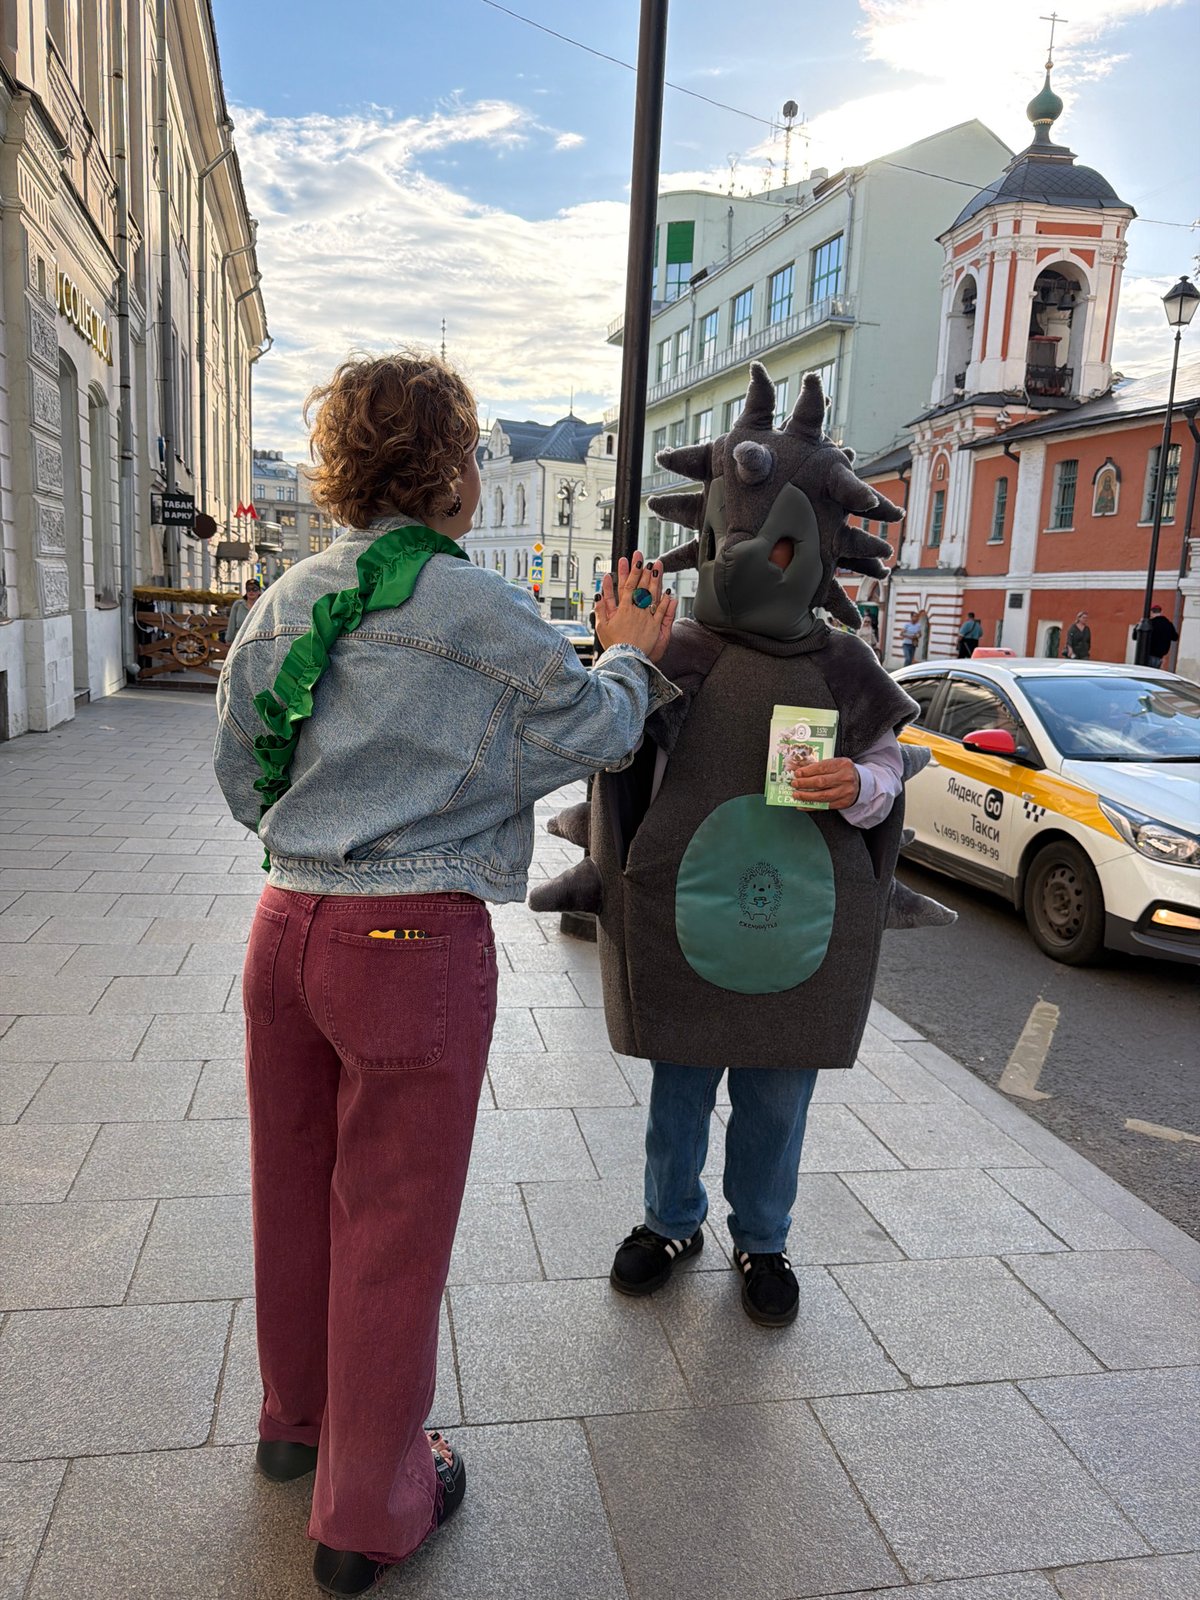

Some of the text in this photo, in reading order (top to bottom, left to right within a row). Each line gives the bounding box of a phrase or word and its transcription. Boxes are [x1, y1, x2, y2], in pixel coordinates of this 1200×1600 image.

[163, 500, 193, 510] ТАБАК
[171, 512, 193, 520] АРКУ
[234, 500, 260, 520] М
[947, 777, 1001, 816] Яндекс Go
[971, 813, 1000, 843] Такси
[941, 825, 999, 861] (495) 999-99-99
